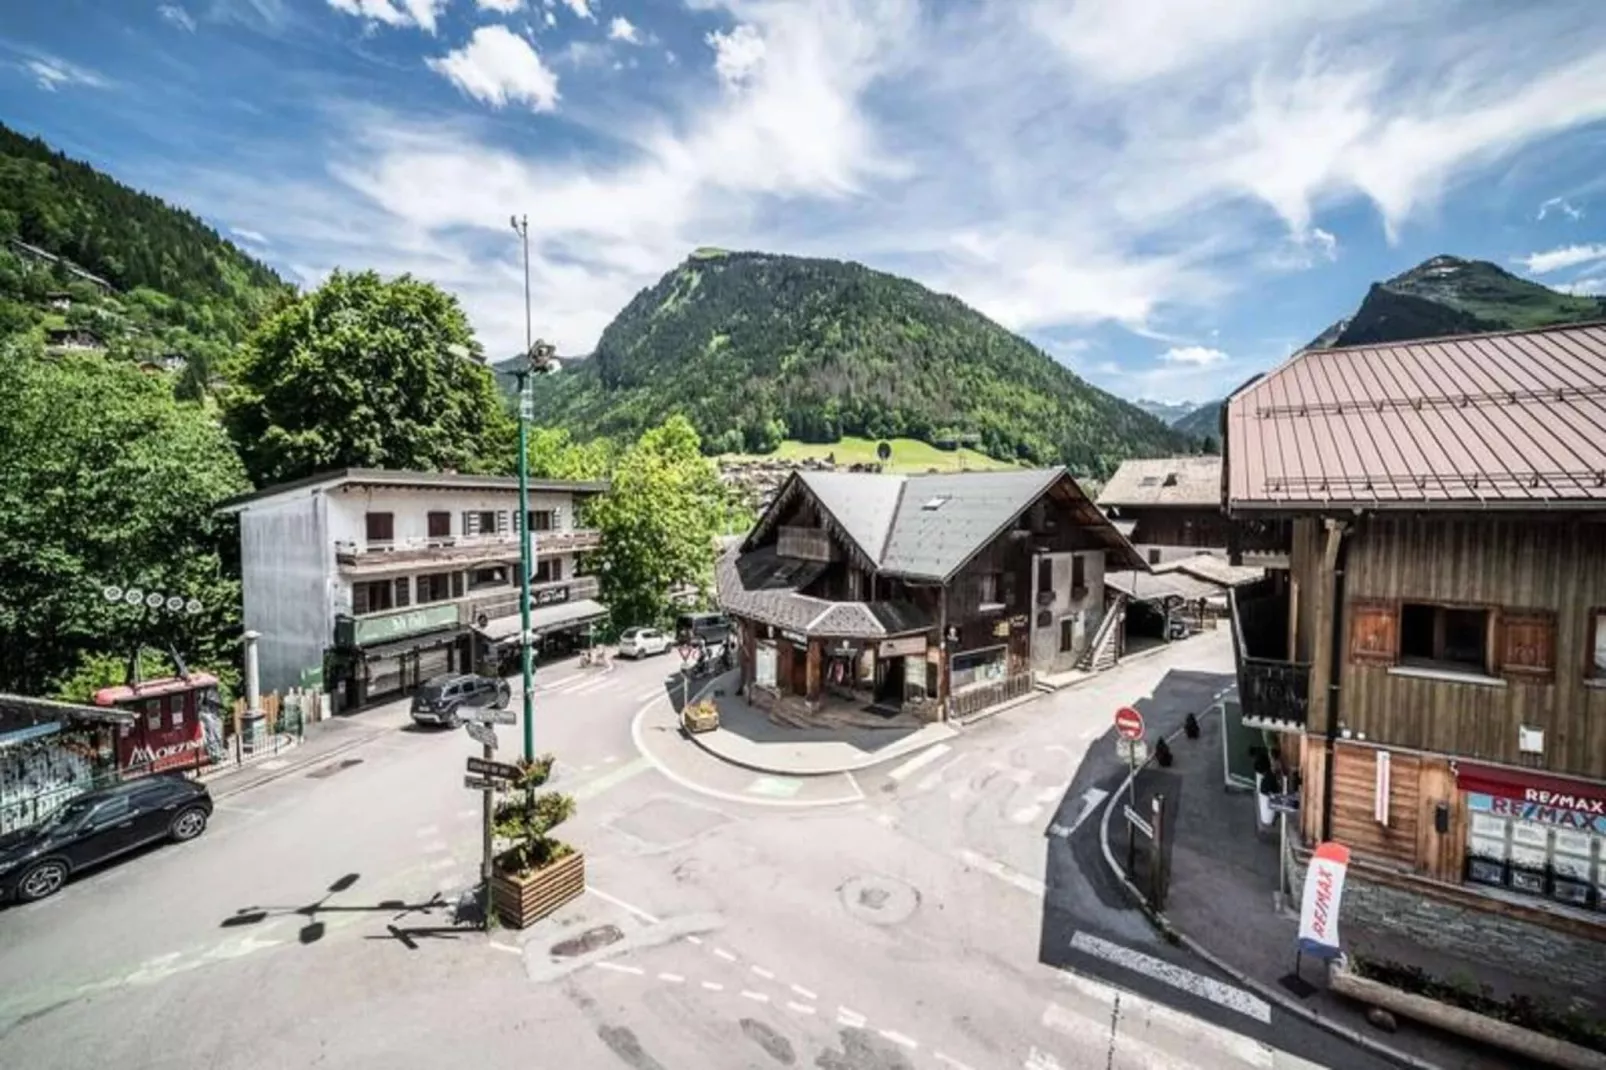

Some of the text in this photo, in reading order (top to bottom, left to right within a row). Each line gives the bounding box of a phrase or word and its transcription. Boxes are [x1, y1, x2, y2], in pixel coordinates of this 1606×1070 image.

[1492, 796, 1599, 832] RE/MAX
[1525, 788, 1604, 814] RE/MAX
[1312, 864, 1333, 938] RE/MAX
